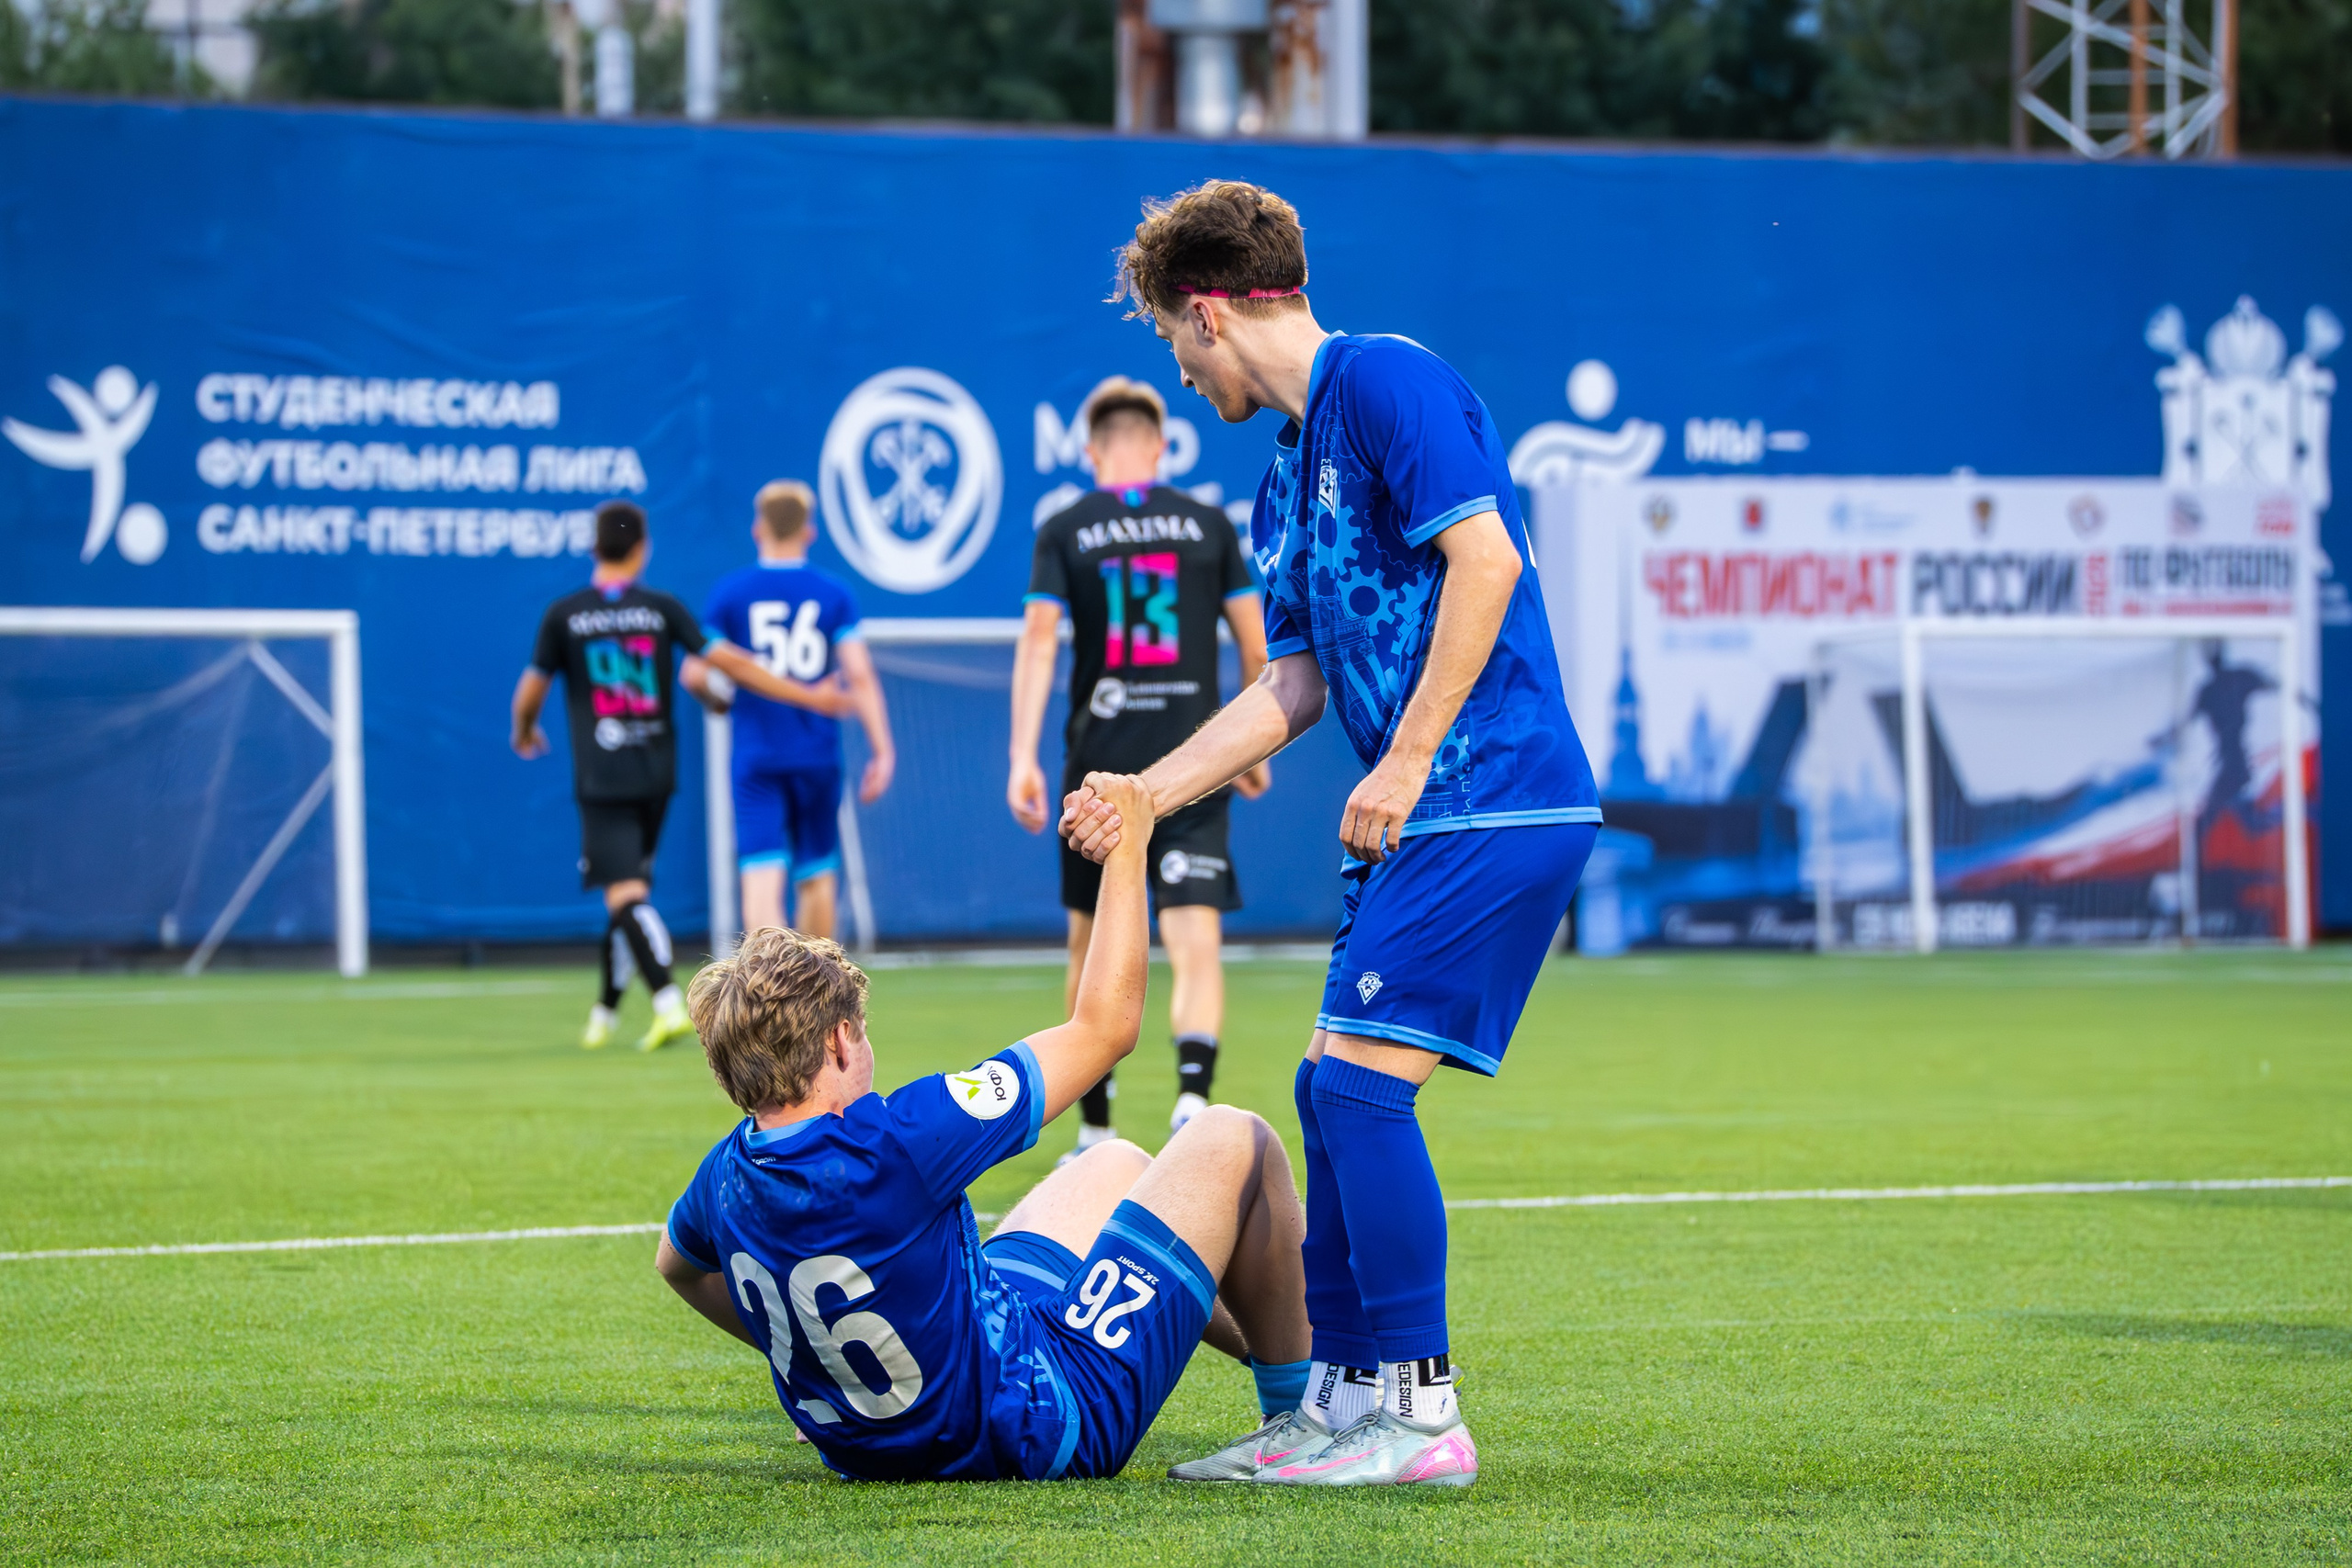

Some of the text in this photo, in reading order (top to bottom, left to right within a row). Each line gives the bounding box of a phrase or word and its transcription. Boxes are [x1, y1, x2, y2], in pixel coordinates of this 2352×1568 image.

[195, 373, 560, 430] СТУДЕНЧЕСКАЯ
[196, 438, 648, 494] ФУТБОЛЬНАЯ ЛИГА
[197, 504, 595, 558] САНКТ-ПЕТЕРБУР
[1077, 515, 1204, 552] MAXIMA
[1099, 553, 1180, 669] 13
[1644, 550, 1898, 618] ЧЕМПИОНАТ
[1912, 550, 2078, 617] РОССИИ
[748, 599, 827, 680] 56
[1116, 1255, 1146, 1274] SPORT
[1065, 1258, 1157, 1349] 26
[730, 1252, 922, 1424] 26
